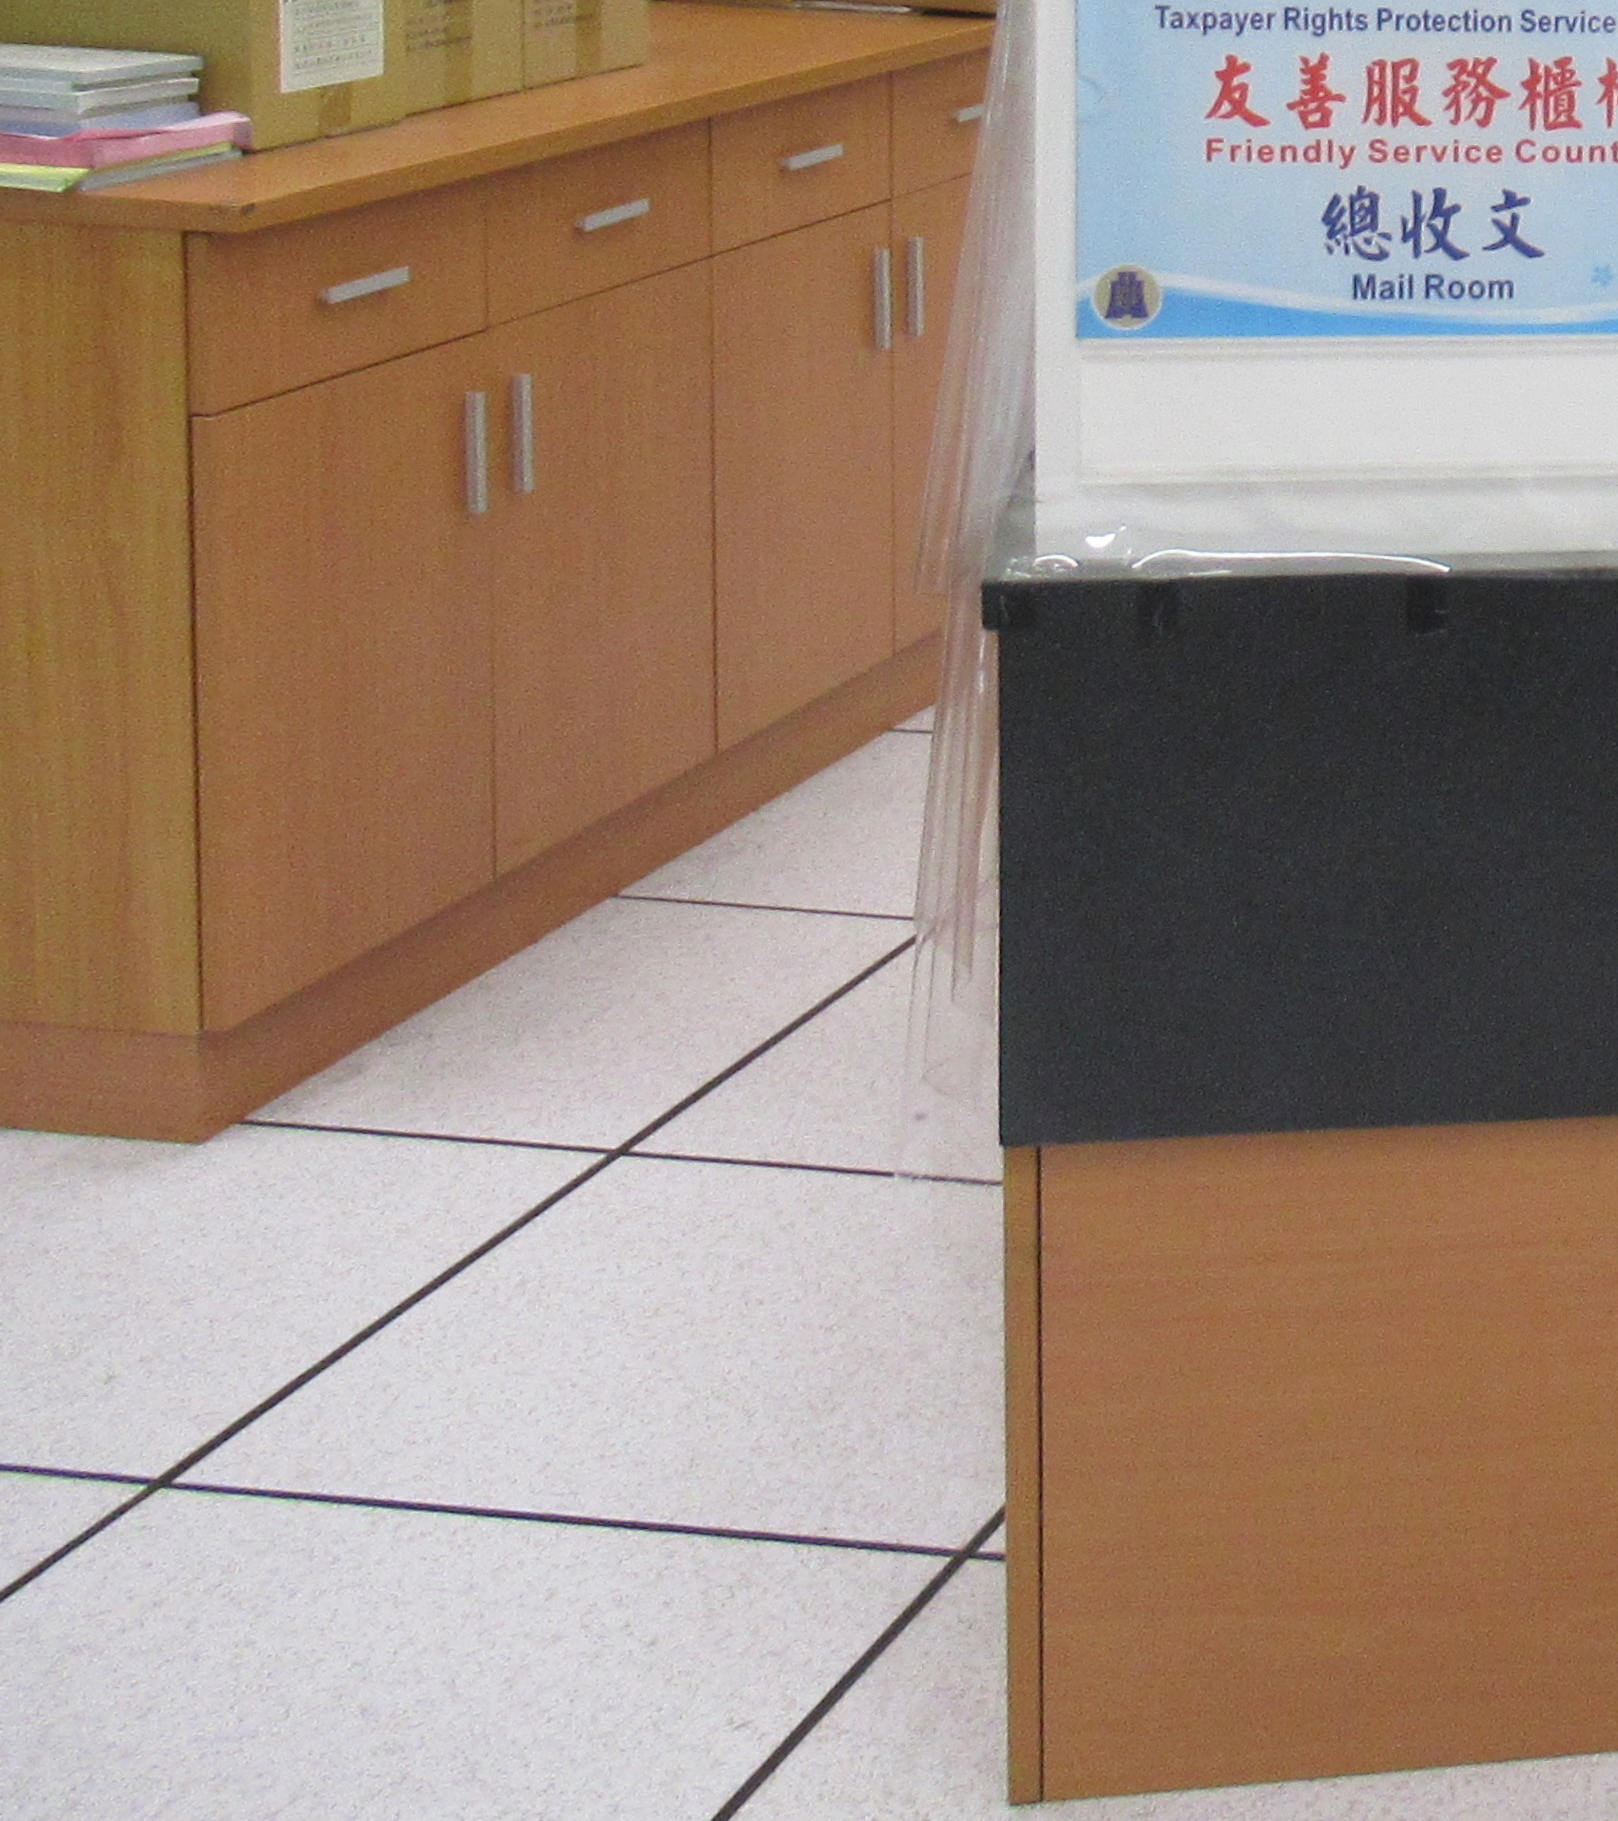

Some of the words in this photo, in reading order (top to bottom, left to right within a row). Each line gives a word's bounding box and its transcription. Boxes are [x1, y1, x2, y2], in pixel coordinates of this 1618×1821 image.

[1154, 4, 1276, 37] Taxpayer
[1283, 6, 1369, 37] Rights
[1376, 7, 1513, 33] Protection
[1519, 8, 1617, 34] Service
[1204, 137, 1357, 170] Friendly
[1367, 137, 1504, 164] Service
[1320, 184, 1545, 262] 總收文
[1352, 273, 1415, 301] Mail
[1424, 274, 1516, 301] Room
